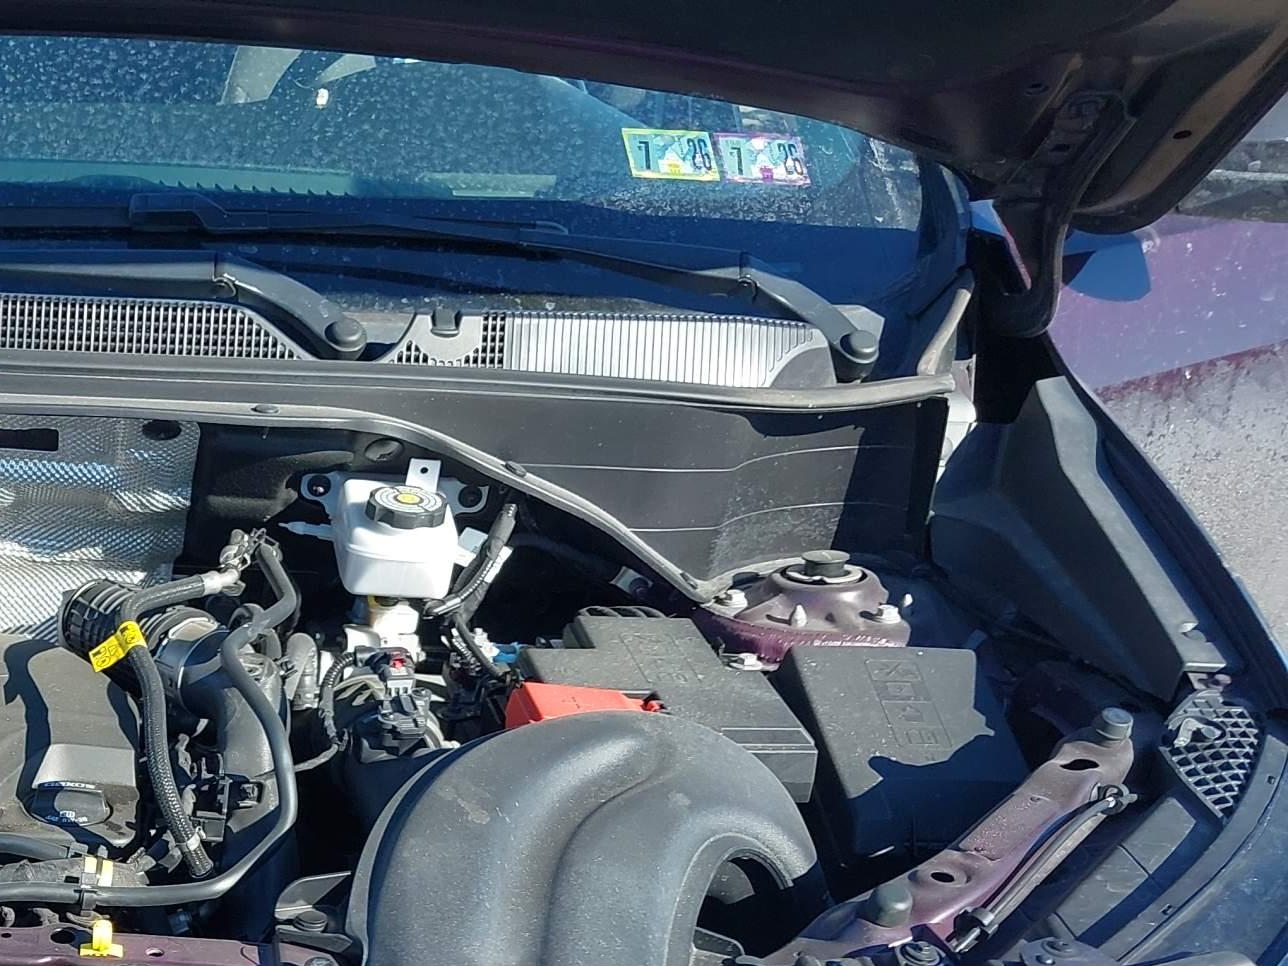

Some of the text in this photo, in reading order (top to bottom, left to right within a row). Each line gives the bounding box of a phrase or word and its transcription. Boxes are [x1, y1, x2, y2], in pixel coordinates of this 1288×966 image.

[637, 137, 713, 171] 7 26
[729, 142, 804, 176] 7 26
